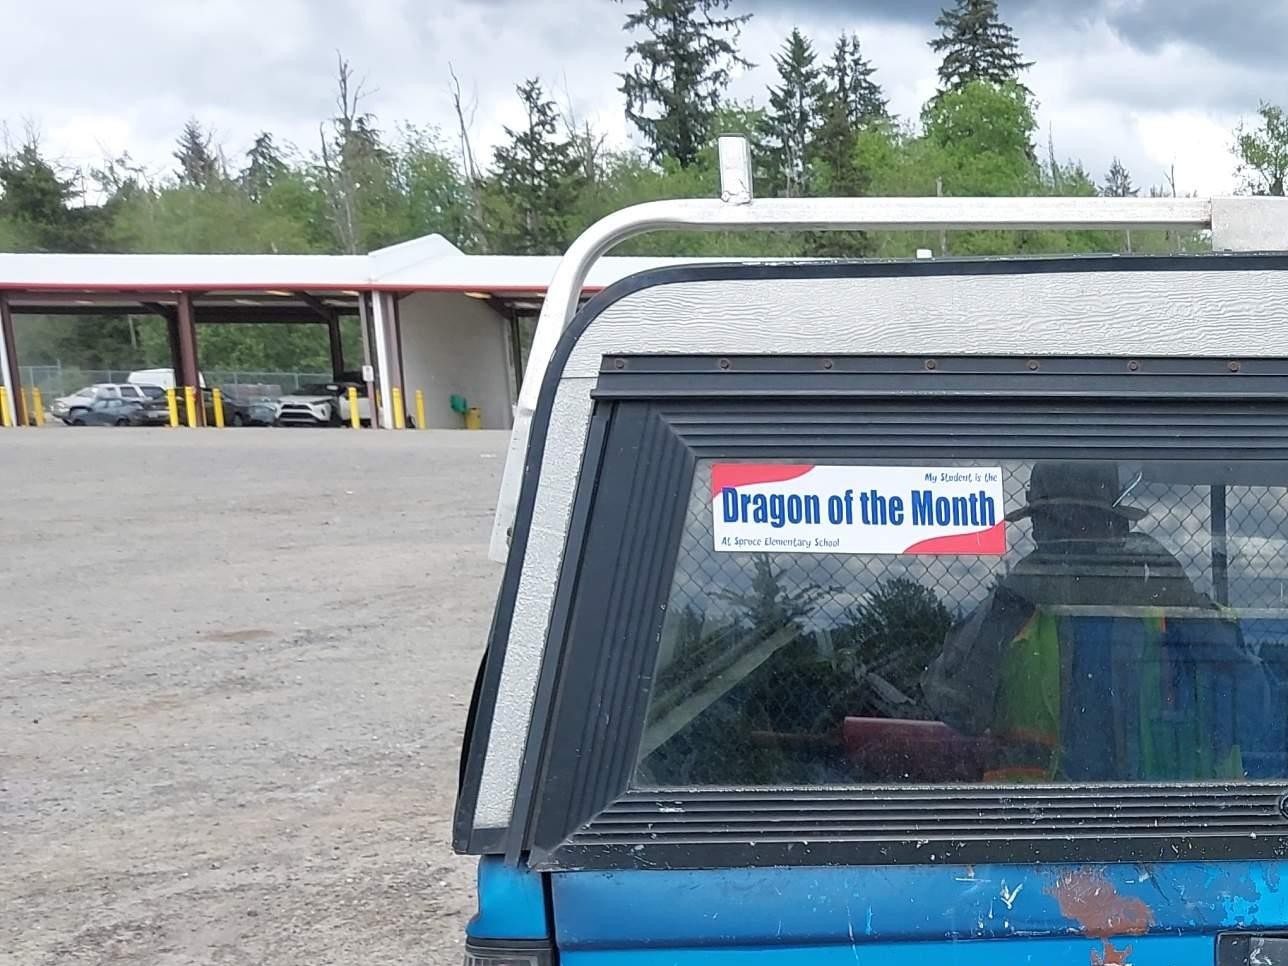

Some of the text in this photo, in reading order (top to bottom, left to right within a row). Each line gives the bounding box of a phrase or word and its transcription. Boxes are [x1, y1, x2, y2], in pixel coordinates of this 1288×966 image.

[924, 472, 998, 483] My Student is the
[721, 486, 995, 529] Dragon of the Month
[721, 536, 840, 549] At Spruce Elementary School
